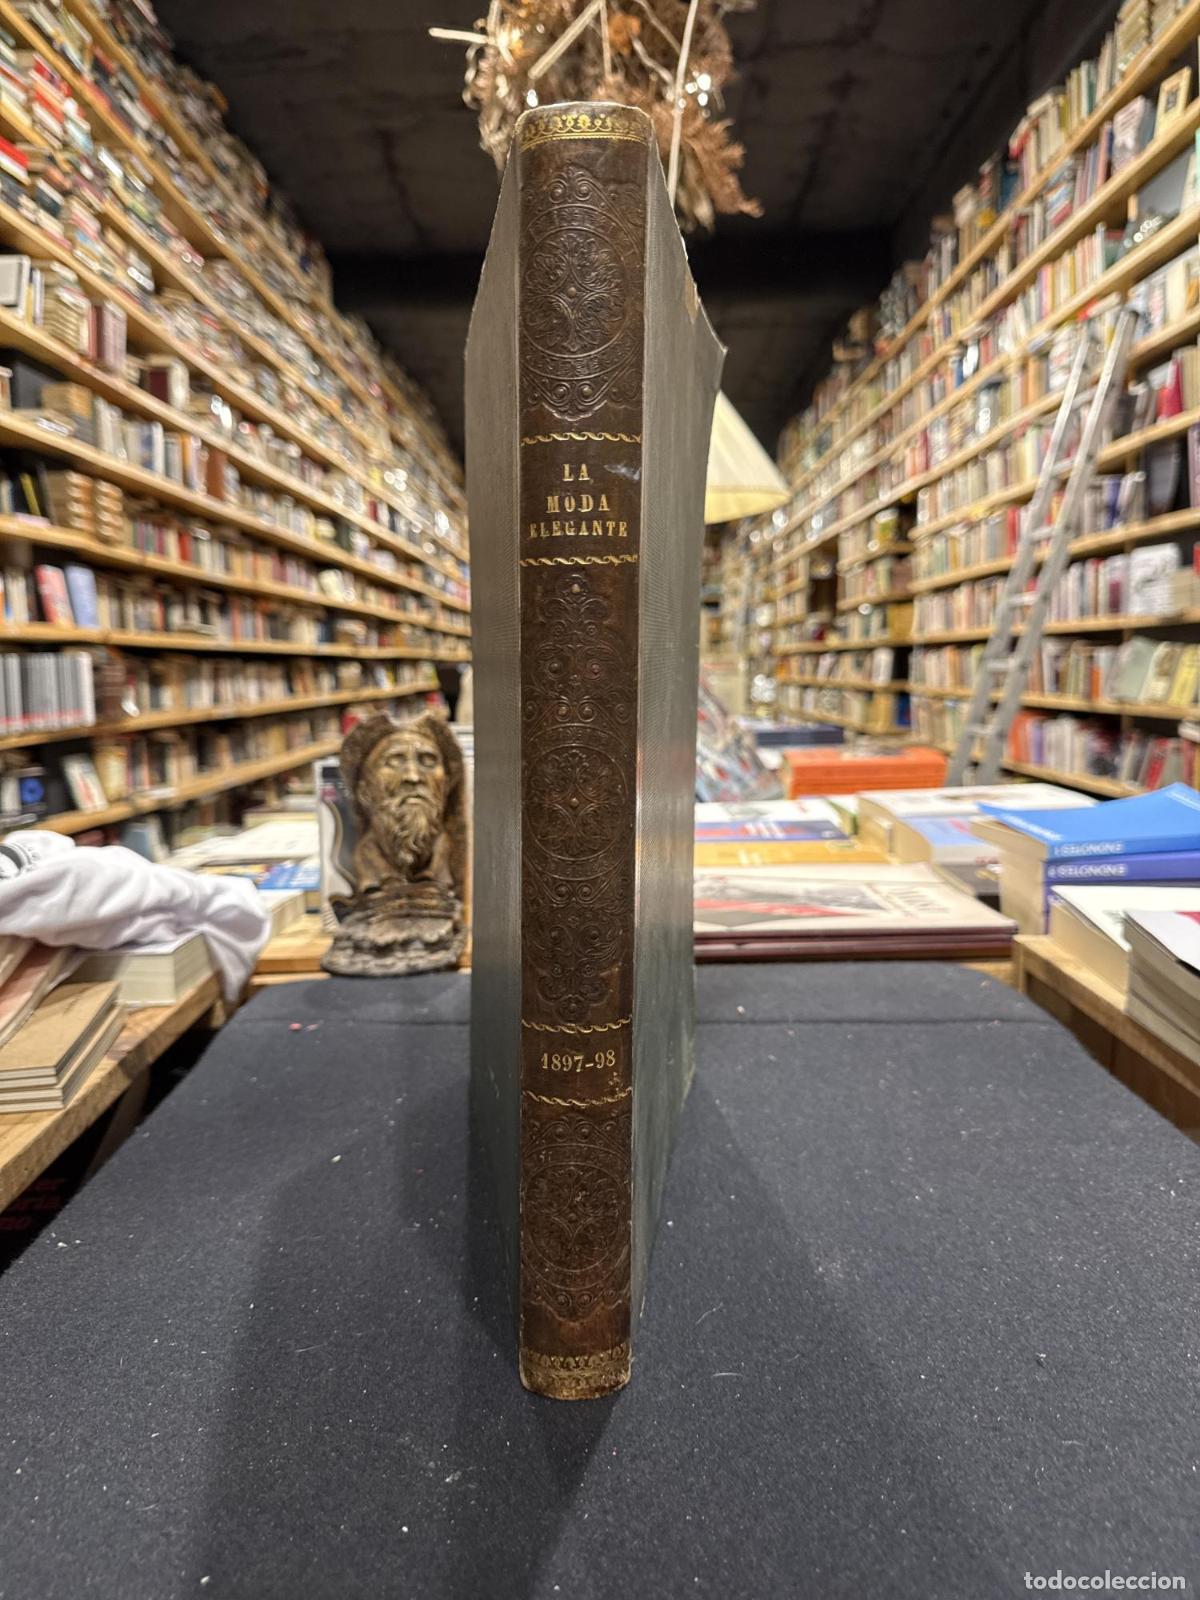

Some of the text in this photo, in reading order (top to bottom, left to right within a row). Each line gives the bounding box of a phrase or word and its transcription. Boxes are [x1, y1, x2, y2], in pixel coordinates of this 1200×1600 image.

[562, 463, 591, 481] LA
[546, 494, 610, 513] MODA
[529, 520, 628, 538] ELEGANTE
[541, 1050, 616, 1072] 1897-98
